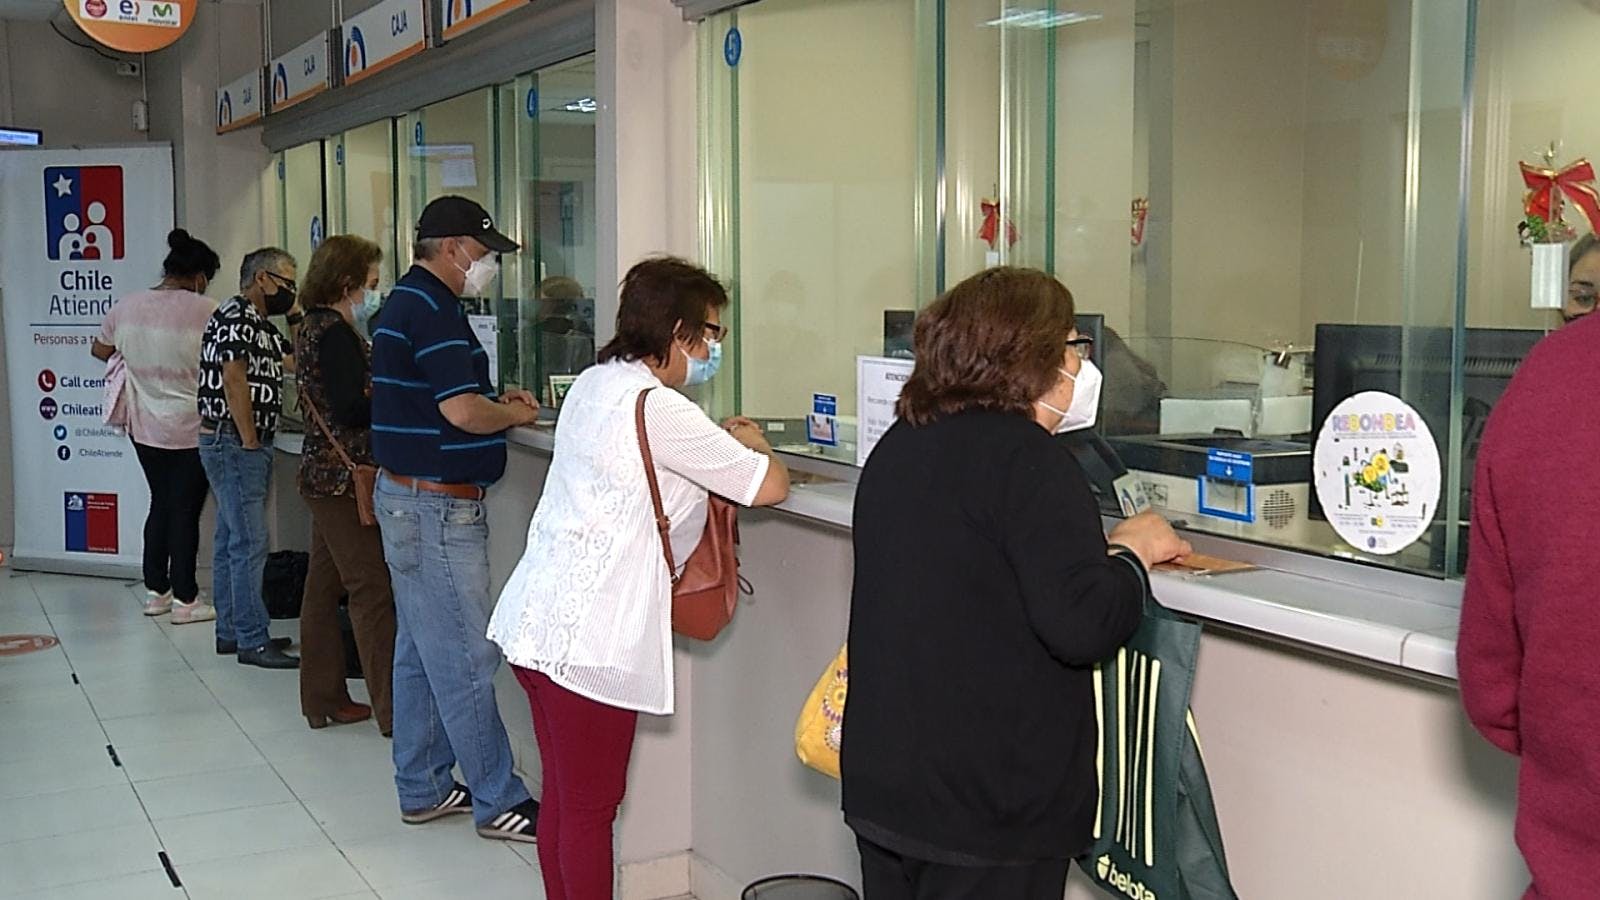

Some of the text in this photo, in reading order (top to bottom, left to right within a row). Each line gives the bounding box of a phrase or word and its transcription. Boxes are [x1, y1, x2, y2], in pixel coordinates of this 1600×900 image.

[391, 9, 408, 37] CAJA
[60, 270, 113, 290] Chile
[49, 293, 119, 316] Atiend
[34, 333, 79, 346] Personas
[80, 336, 87, 344] a
[60, 376, 81, 388] Call
